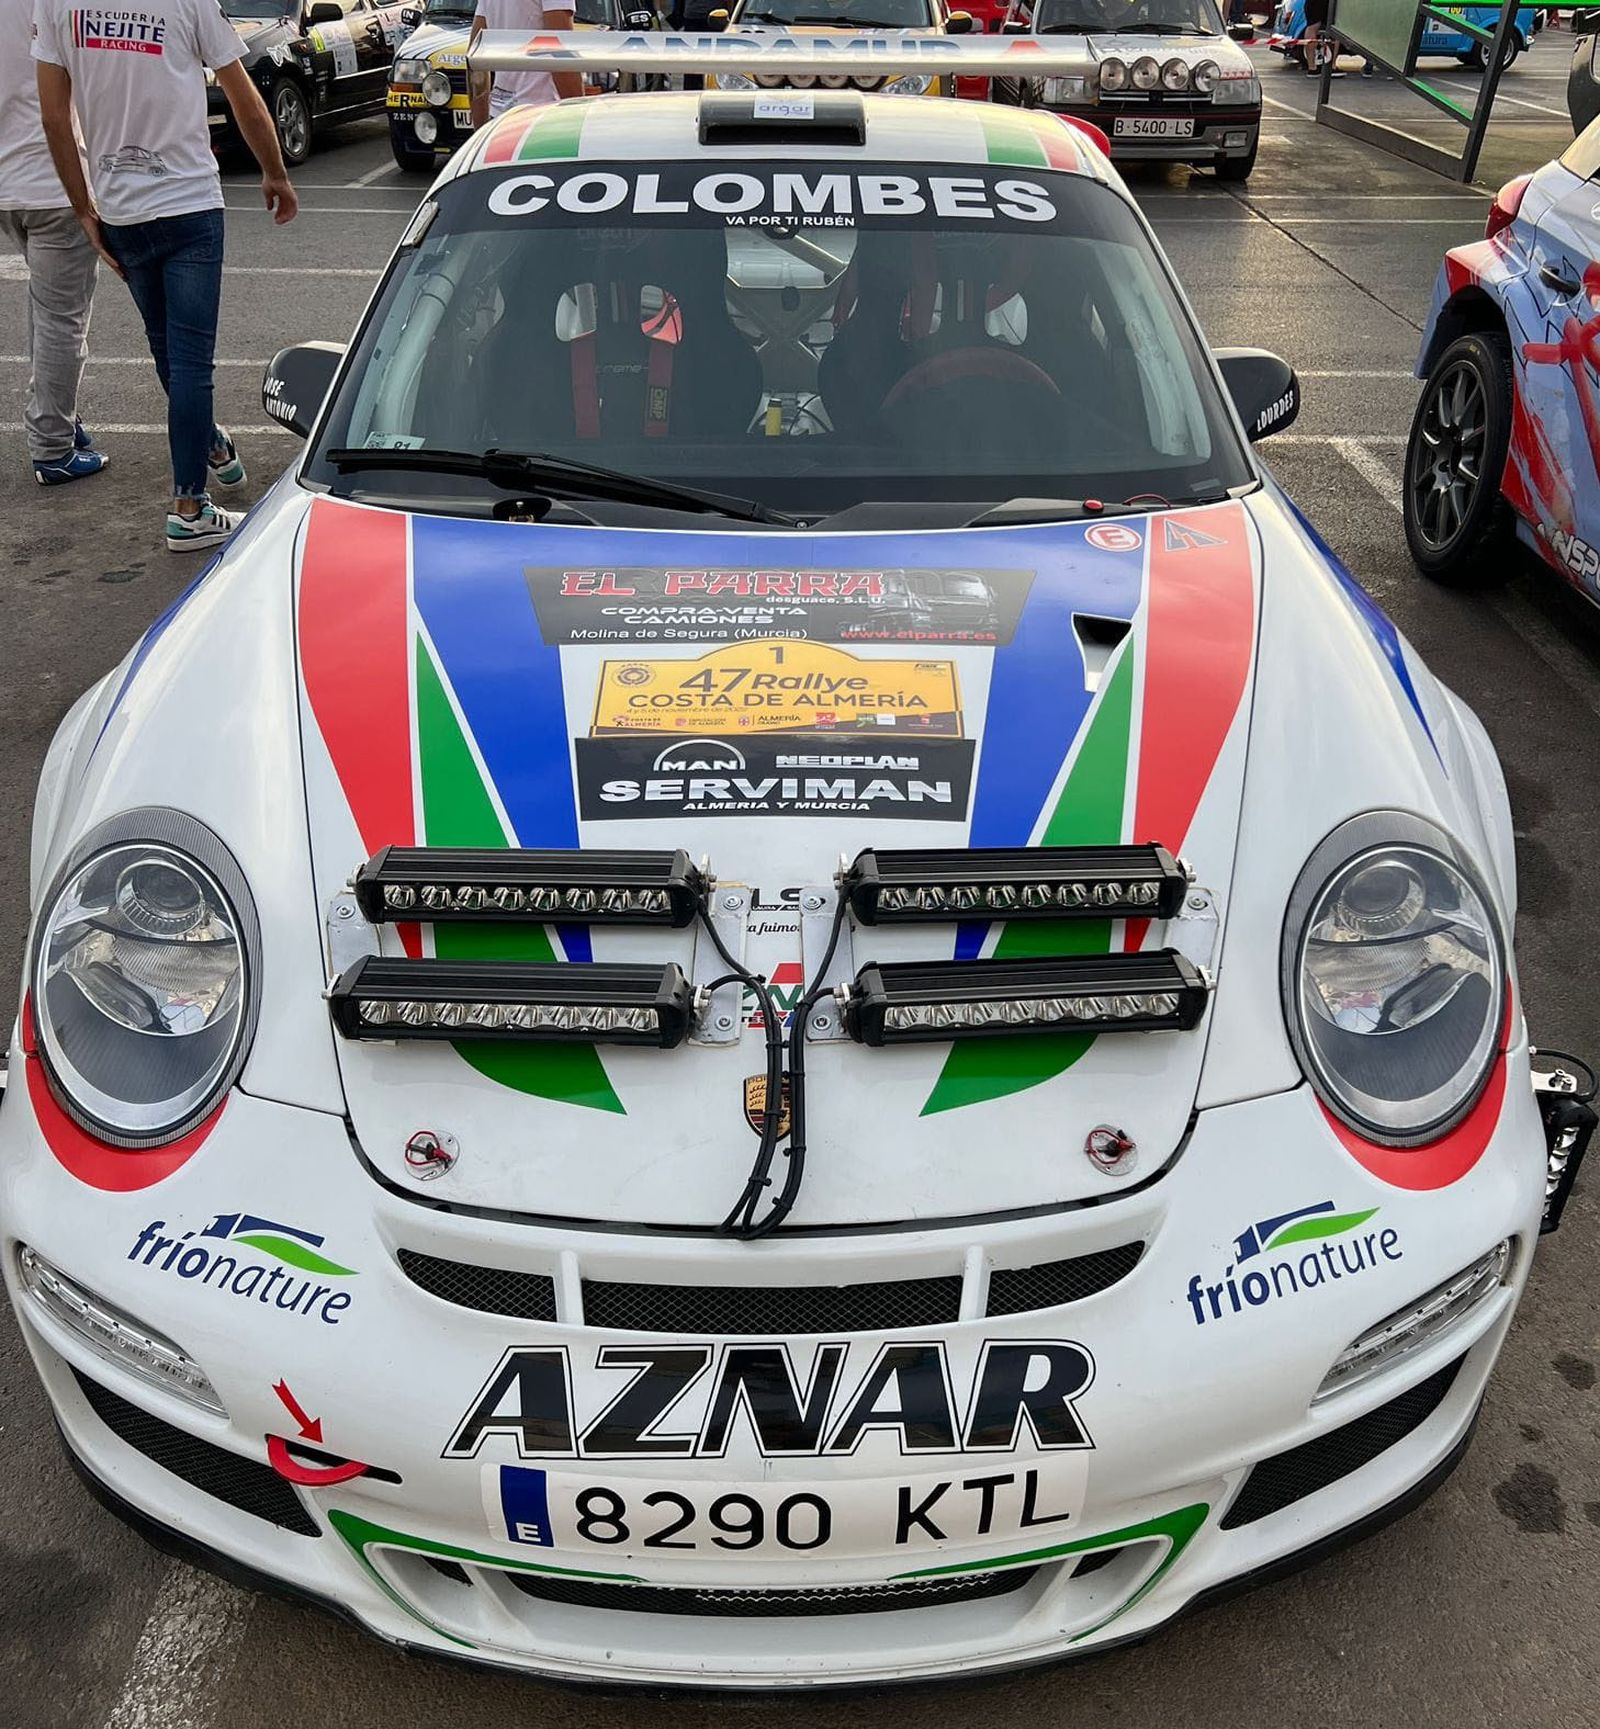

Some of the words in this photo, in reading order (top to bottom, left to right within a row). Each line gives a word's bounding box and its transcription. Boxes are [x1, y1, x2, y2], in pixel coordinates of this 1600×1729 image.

[86, 10, 166, 26] ESCUDERIA
[86, 20, 165, 43] NEJITE
[100, 40, 147, 52] RACING
[758, 103, 811, 116] argar
[1133, 120, 1167, 134] 5400
[1175, 121, 1193, 134] LS
[487, 172, 1057, 222] COLOMBES
[725, 216, 745, 225] VA
[749, 216, 781, 225] POR
[785, 216, 798, 225] TI
[802, 215, 855, 226] RUBÉN
[265, 397, 297, 421] ANTONIO
[1256, 389, 1294, 432] LOURDES
[560, 571, 636, 596] EL
[664, 571, 884, 596] PARRA
[601, 607, 808, 615] COMPRA-VENTA
[623, 615, 774, 624] CAMIONES
[570, 629, 629, 639] Molina
[635, 629, 657, 638] de
[663, 629, 728, 640] Segura
[734, 629, 808, 640] (Murcia)
[769, 646, 784, 664] 1
[679, 668, 752, 692] 47
[751, 673, 869, 693] Rallye
[628, 693, 733, 707] COSTA
[744, 693, 783, 706] DE
[793, 691, 928, 708] ALMERÍA
[660, 760, 738, 771] MAN
[775, 755, 919, 768] NEOPLAN
[599, 777, 952, 803] SERVIMAN
[682, 802, 769, 811] ALMERIA
[775, 802, 790, 810] Y
[794, 801, 870, 811] MURCIA
[757, 921, 800, 935] fuimo
[127, 1220, 352, 1324] fríonature
[1187, 1228, 1403, 1325] fríonature
[440, 1338, 1097, 1459] AZNAR
[516, 1523, 540, 1542] E
[575, 1487, 832, 1551] 8290
[895, 1468, 1070, 1546] KTL
